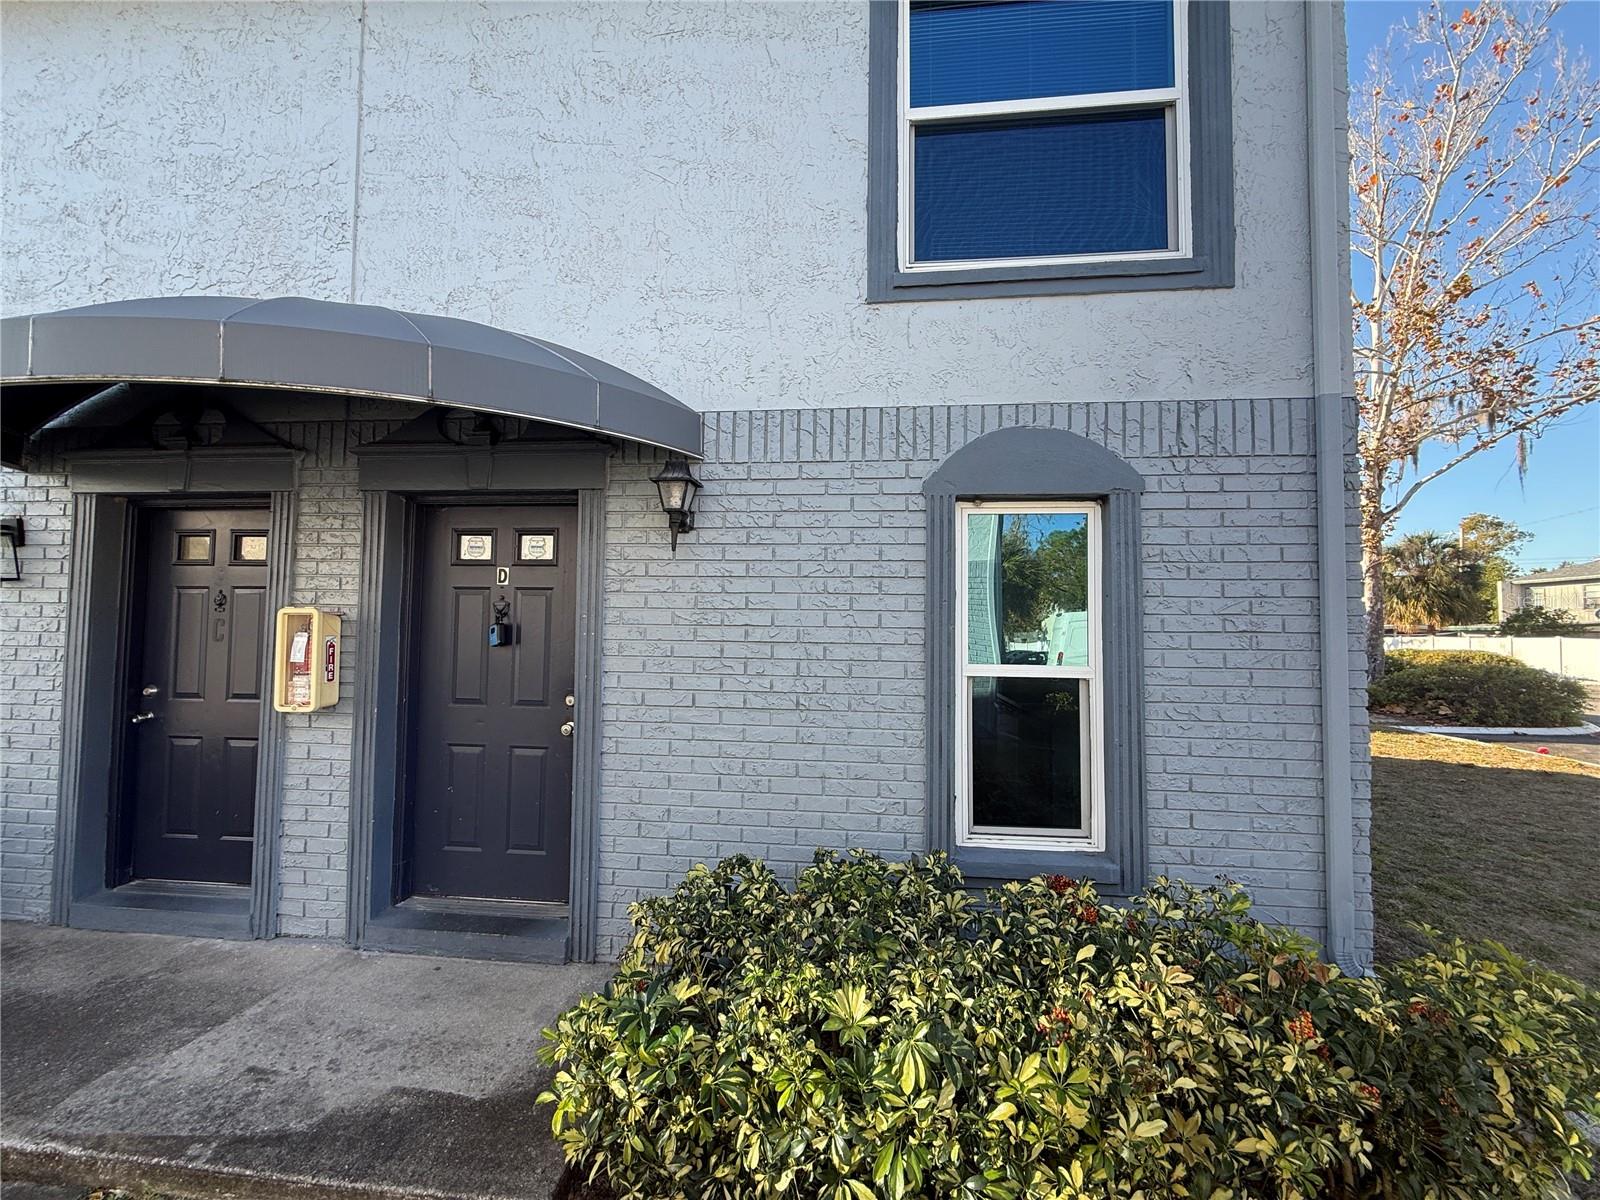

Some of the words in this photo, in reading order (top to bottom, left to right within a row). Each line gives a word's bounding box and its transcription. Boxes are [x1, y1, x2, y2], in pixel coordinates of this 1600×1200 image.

[498, 568, 507, 583] D
[212, 618, 225, 642] C
[327, 647, 335, 680] FIRE
